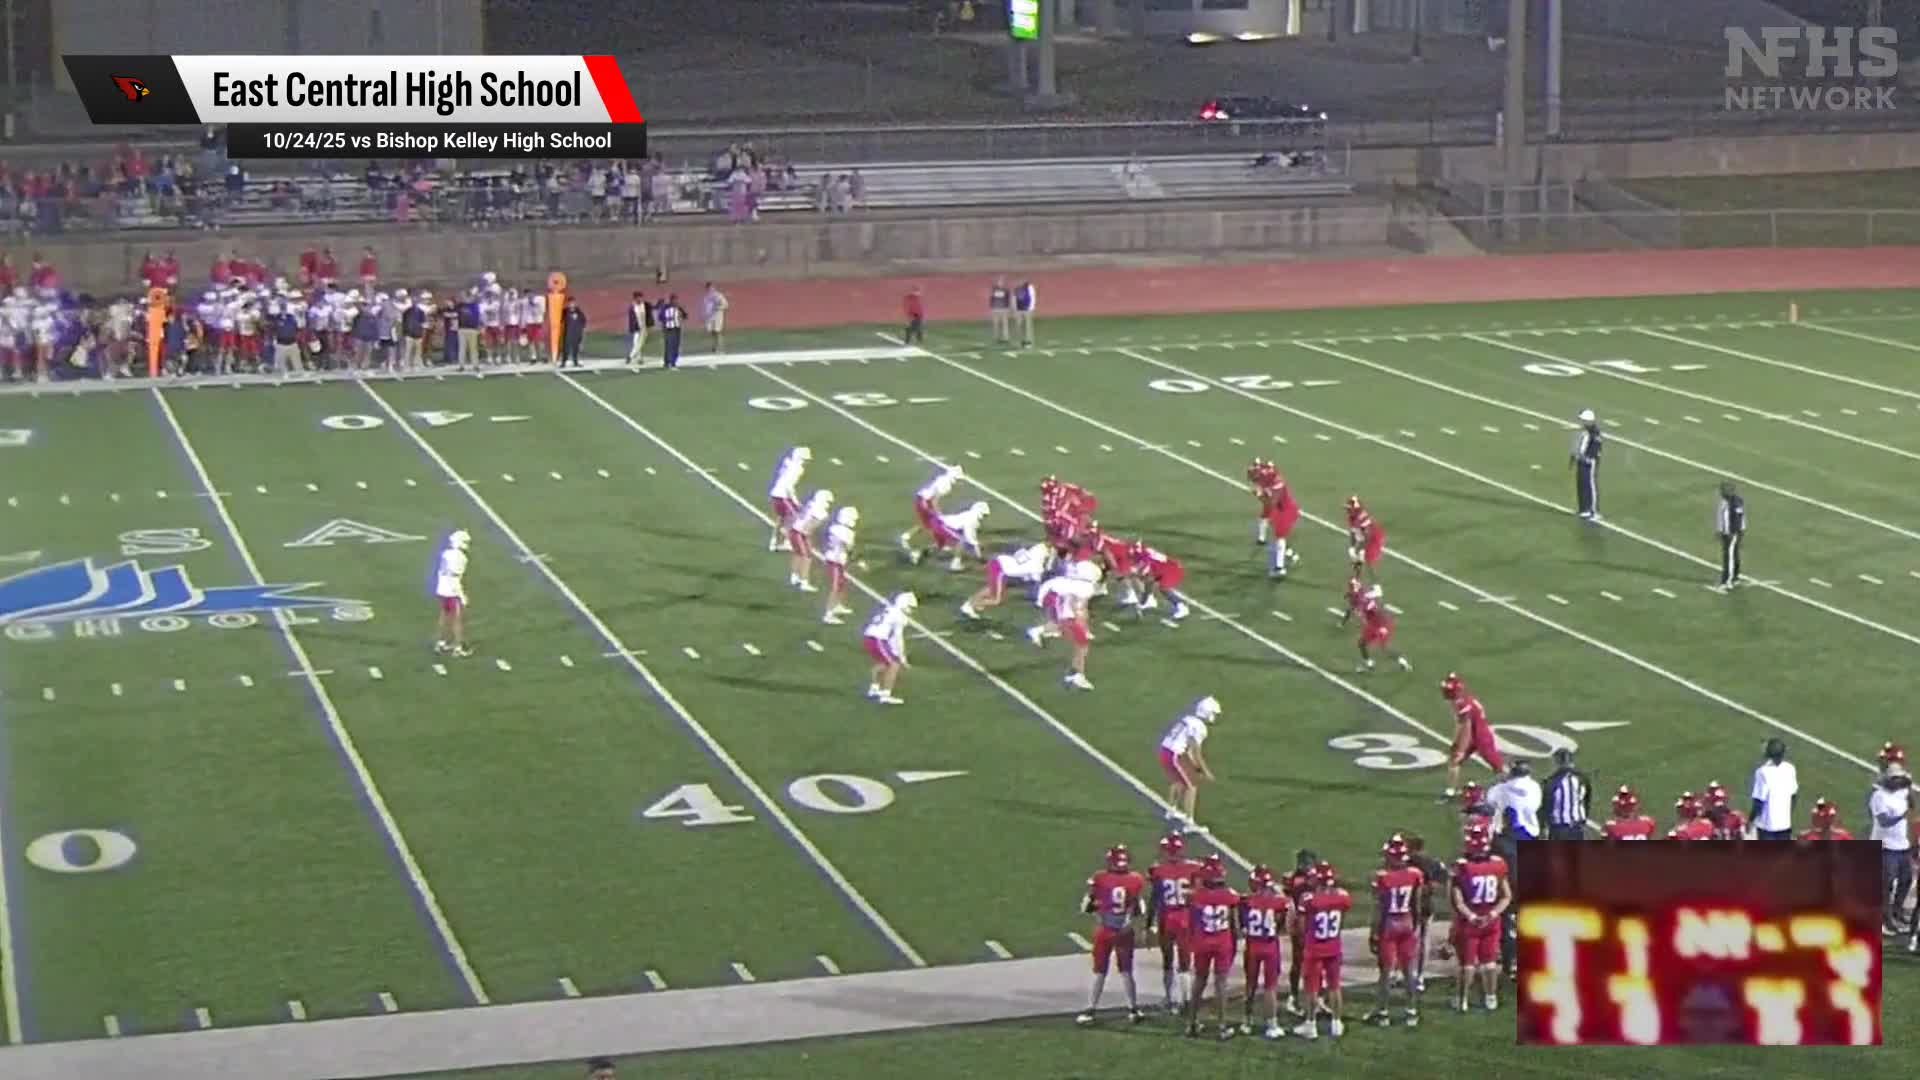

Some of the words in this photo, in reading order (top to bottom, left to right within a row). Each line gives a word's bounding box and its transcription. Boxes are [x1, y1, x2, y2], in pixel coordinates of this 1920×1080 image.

[1111, 886, 1127, 914] 9
[1388, 885, 1413, 913] 17
[1471, 875, 1498, 904] 78
[1247, 908, 1276, 937] 24
[1314, 909, 1341, 940] 33
